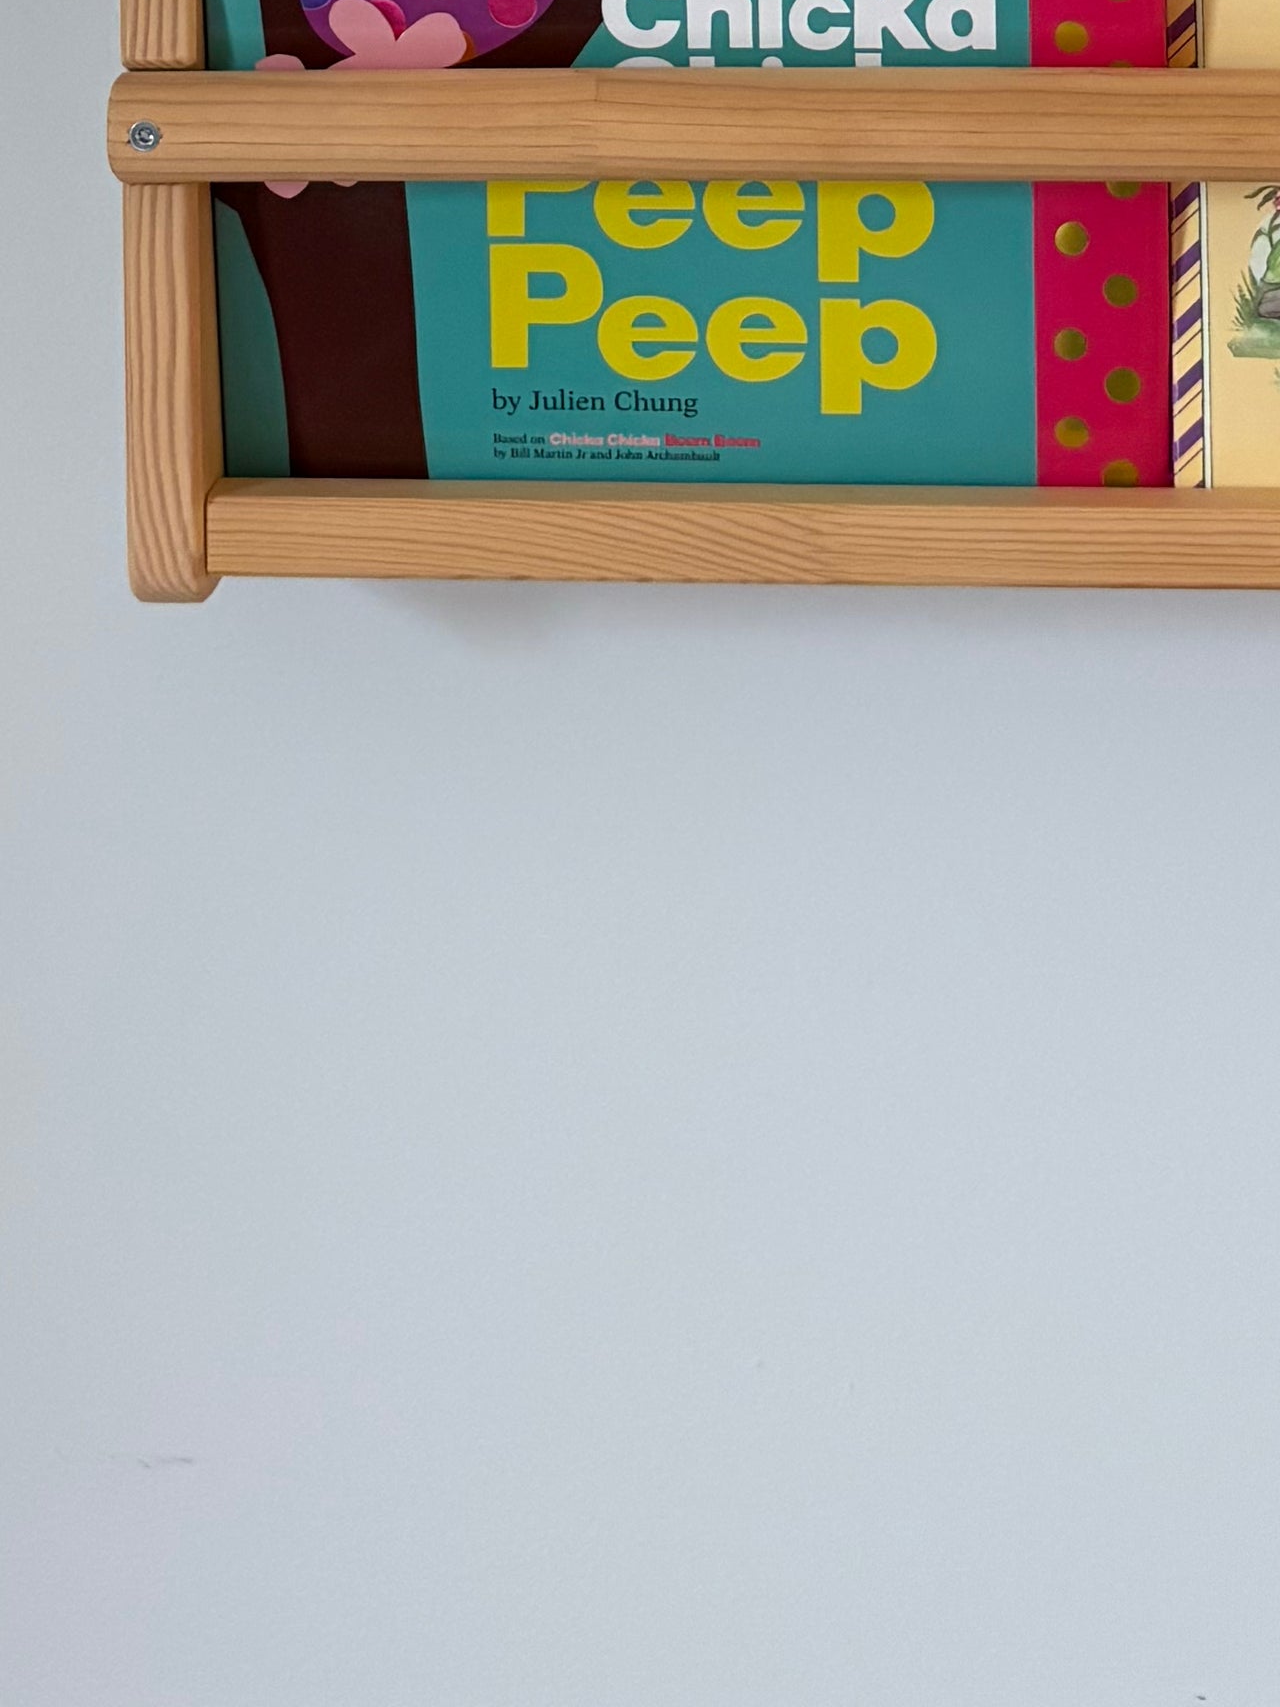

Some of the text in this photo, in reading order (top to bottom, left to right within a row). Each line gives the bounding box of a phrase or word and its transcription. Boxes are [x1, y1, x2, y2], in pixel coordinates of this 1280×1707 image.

[489, 243, 938, 415] Peep
[492, 388, 699, 418] by Julien Chung
[493, 447, 507, 460] by
[511, 447, 530, 459] Bill
[534, 448, 573, 459] Martin
[590, 448, 612, 460] and
